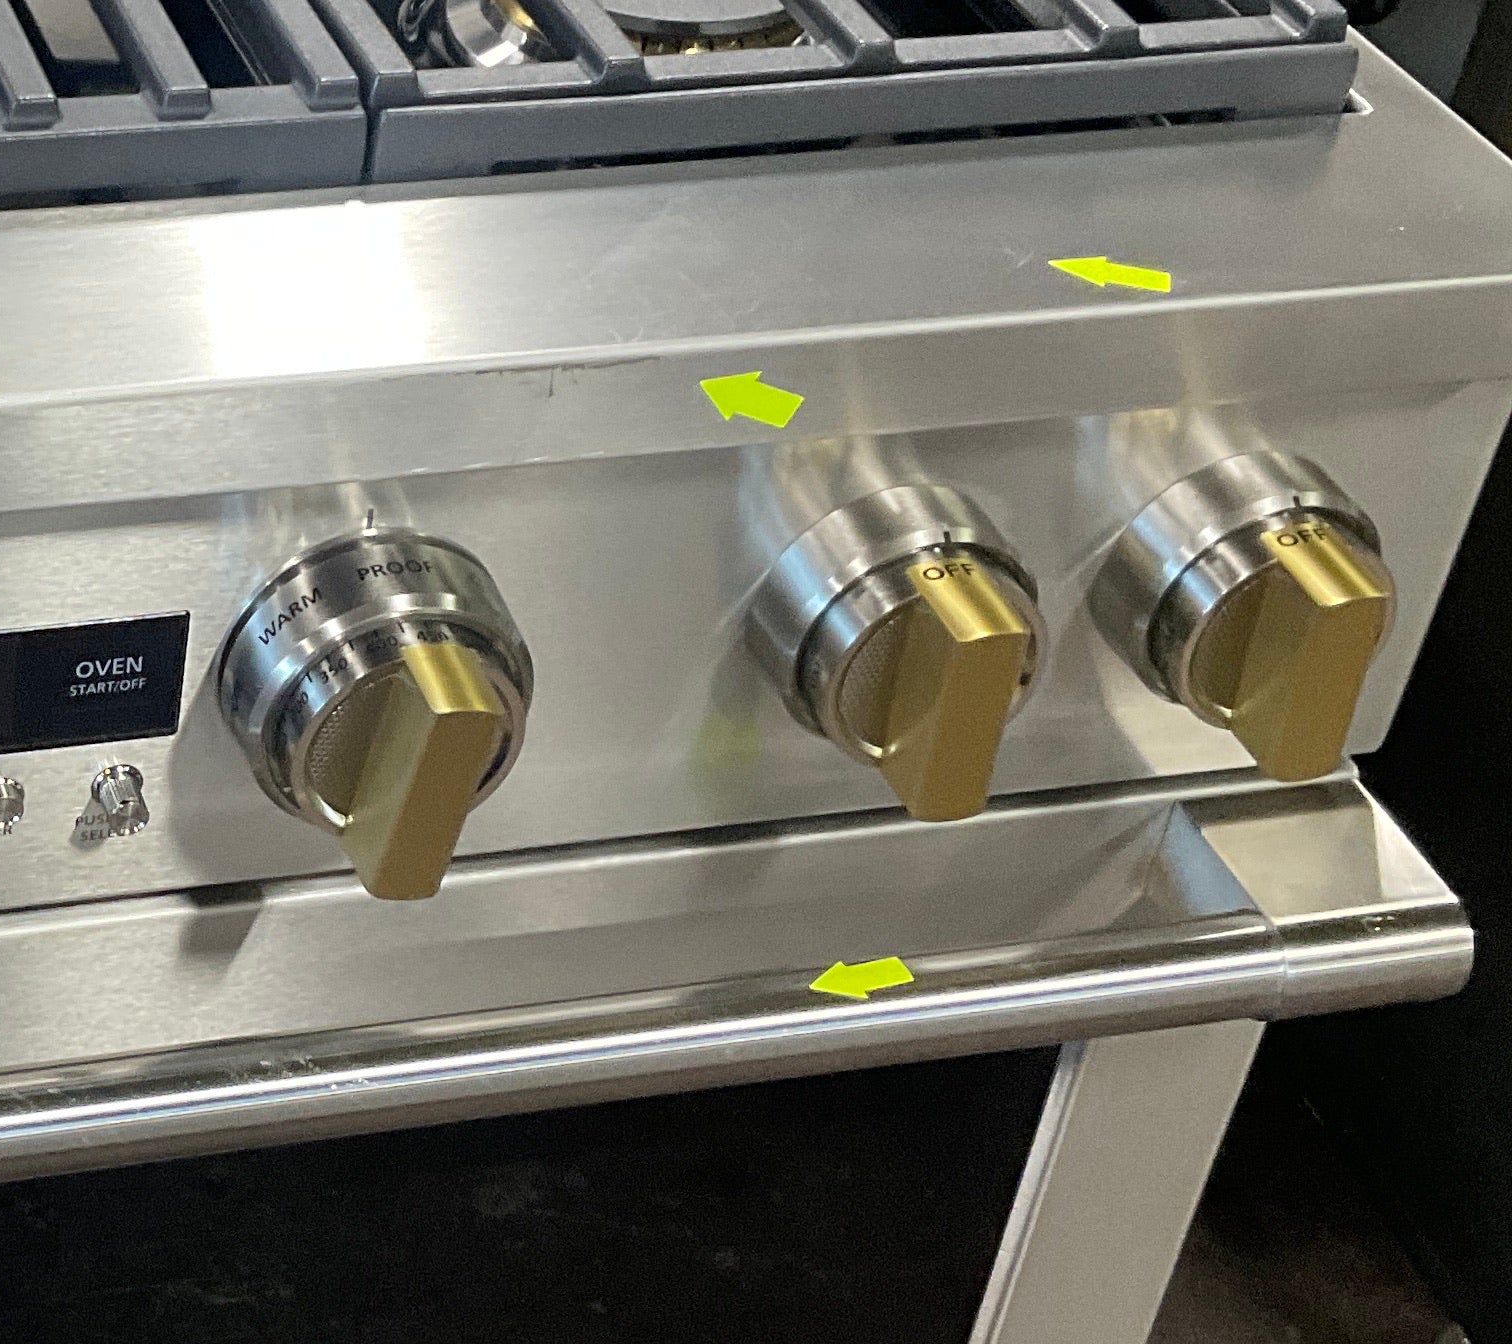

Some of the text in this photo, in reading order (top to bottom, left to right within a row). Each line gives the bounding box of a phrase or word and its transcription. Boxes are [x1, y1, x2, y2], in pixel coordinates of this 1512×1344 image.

[1276, 527, 1326, 547] OFF
[357, 559, 433, 581] PROOF
[922, 563, 975, 581] OFF
[258, 587, 323, 646] WARM
[75, 656, 144, 679] OVEN
[69, 677, 147, 697] START/OFF
